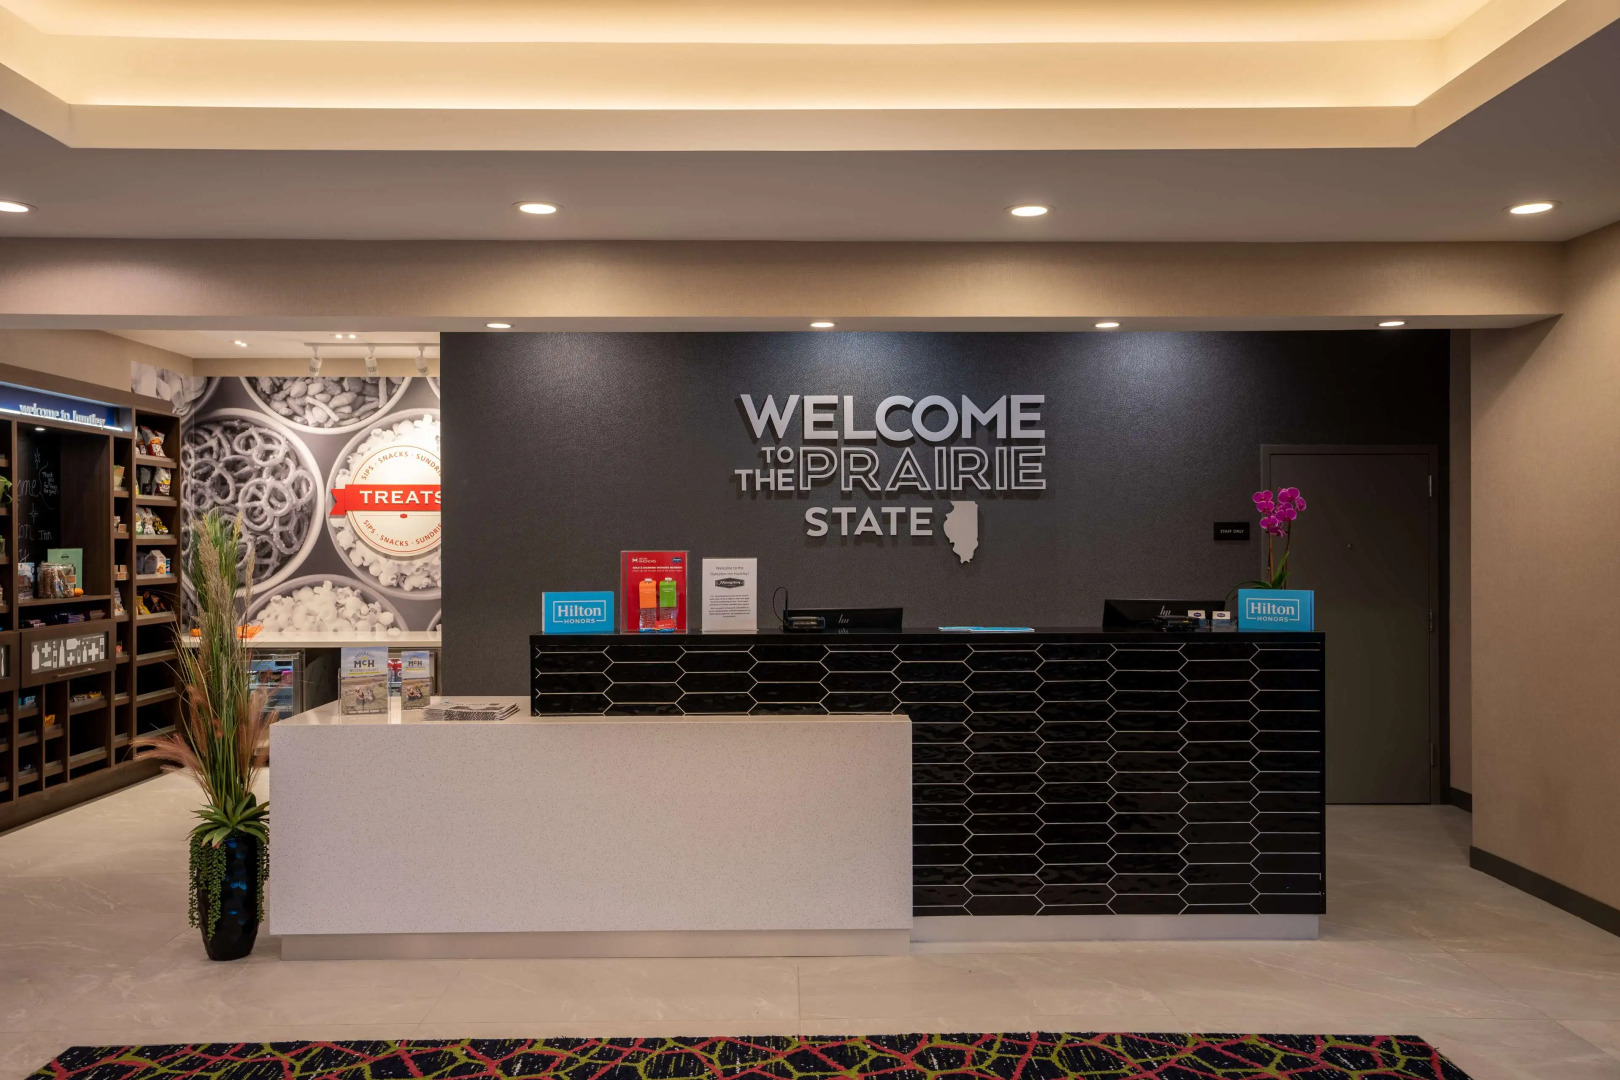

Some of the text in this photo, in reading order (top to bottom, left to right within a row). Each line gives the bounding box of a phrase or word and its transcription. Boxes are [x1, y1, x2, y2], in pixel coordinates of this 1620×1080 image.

[19, 403, 106, 430] welcome to huntley
[740, 394, 1045, 442] WELCOME
[361, 466, 374, 480] SIPS
[378, 451, 408, 464] SNACKS
[734, 446, 1046, 491] THE PRAIRIE
[762, 446, 794, 464] TO
[363, 520, 376, 534] SIPS
[380, 534, 409, 546] SNACKS
[805, 506, 932, 536] STATE
[558, 605, 602, 617] Hilton
[1250, 602, 1295, 615] Hilton
